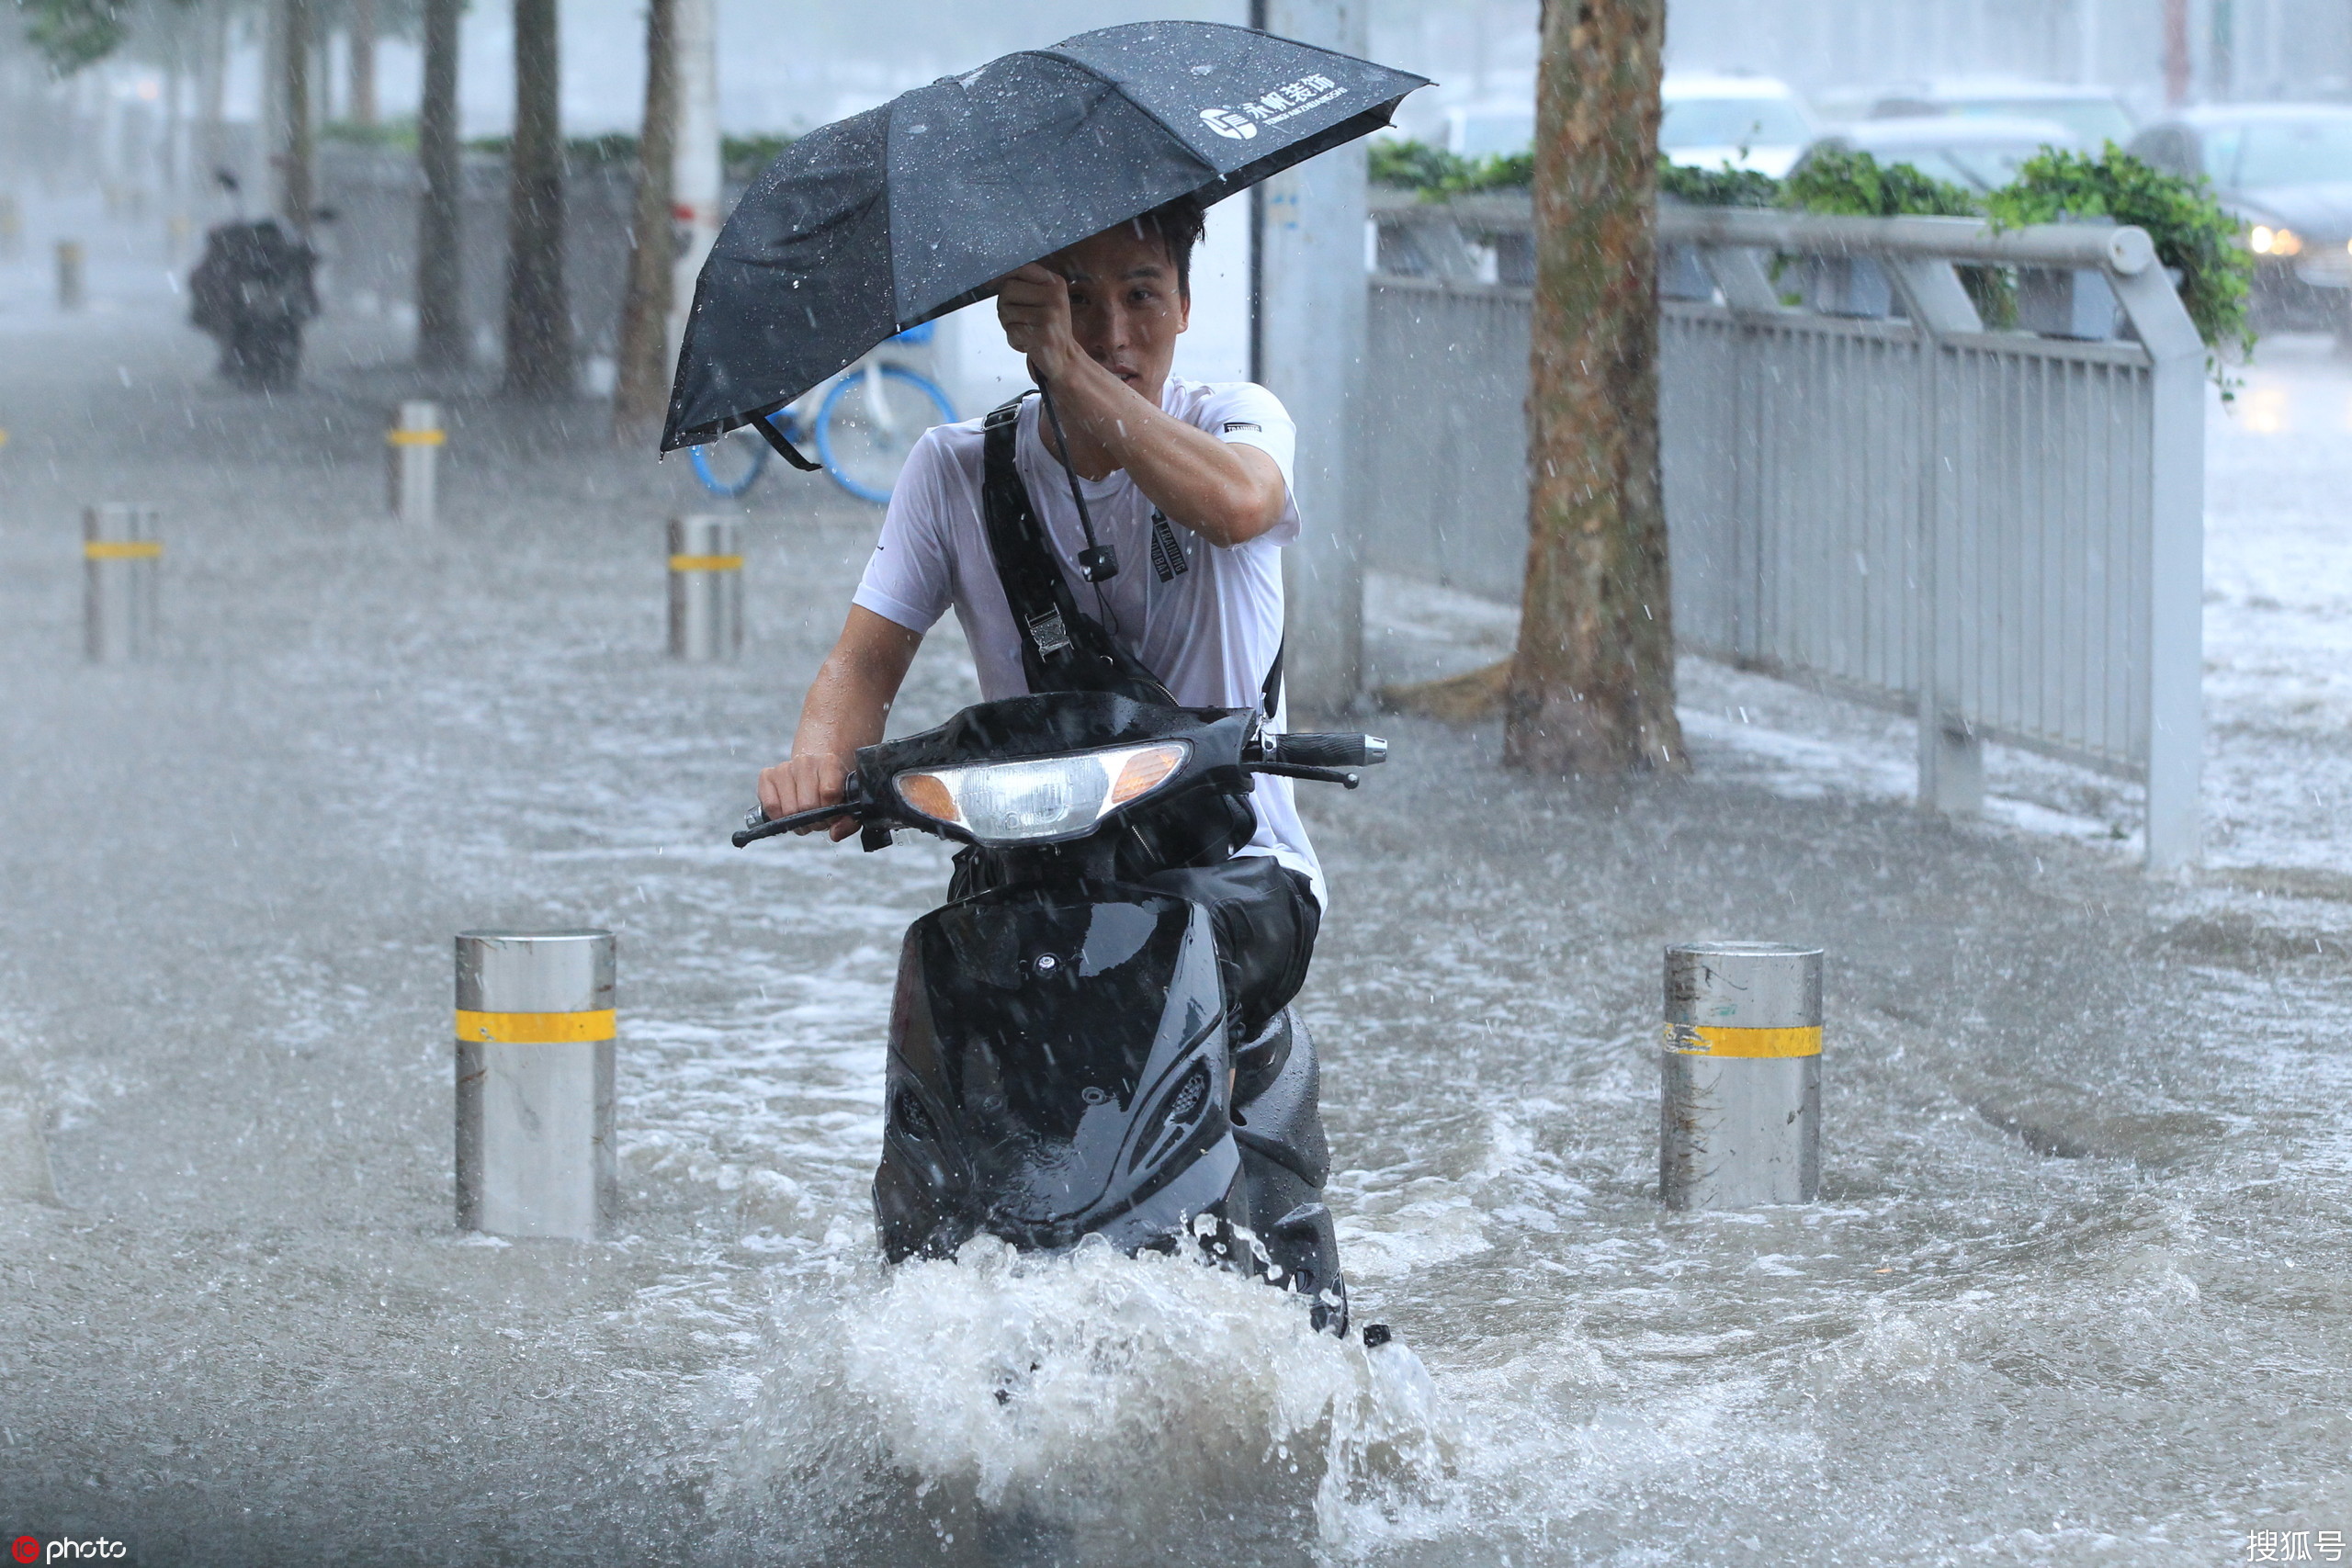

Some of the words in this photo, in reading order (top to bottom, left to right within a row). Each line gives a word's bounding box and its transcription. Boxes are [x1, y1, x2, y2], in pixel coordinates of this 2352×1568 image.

[1243, 73, 1335, 119] 永帆装饰
[1159, 527, 1186, 571] TRAINING
